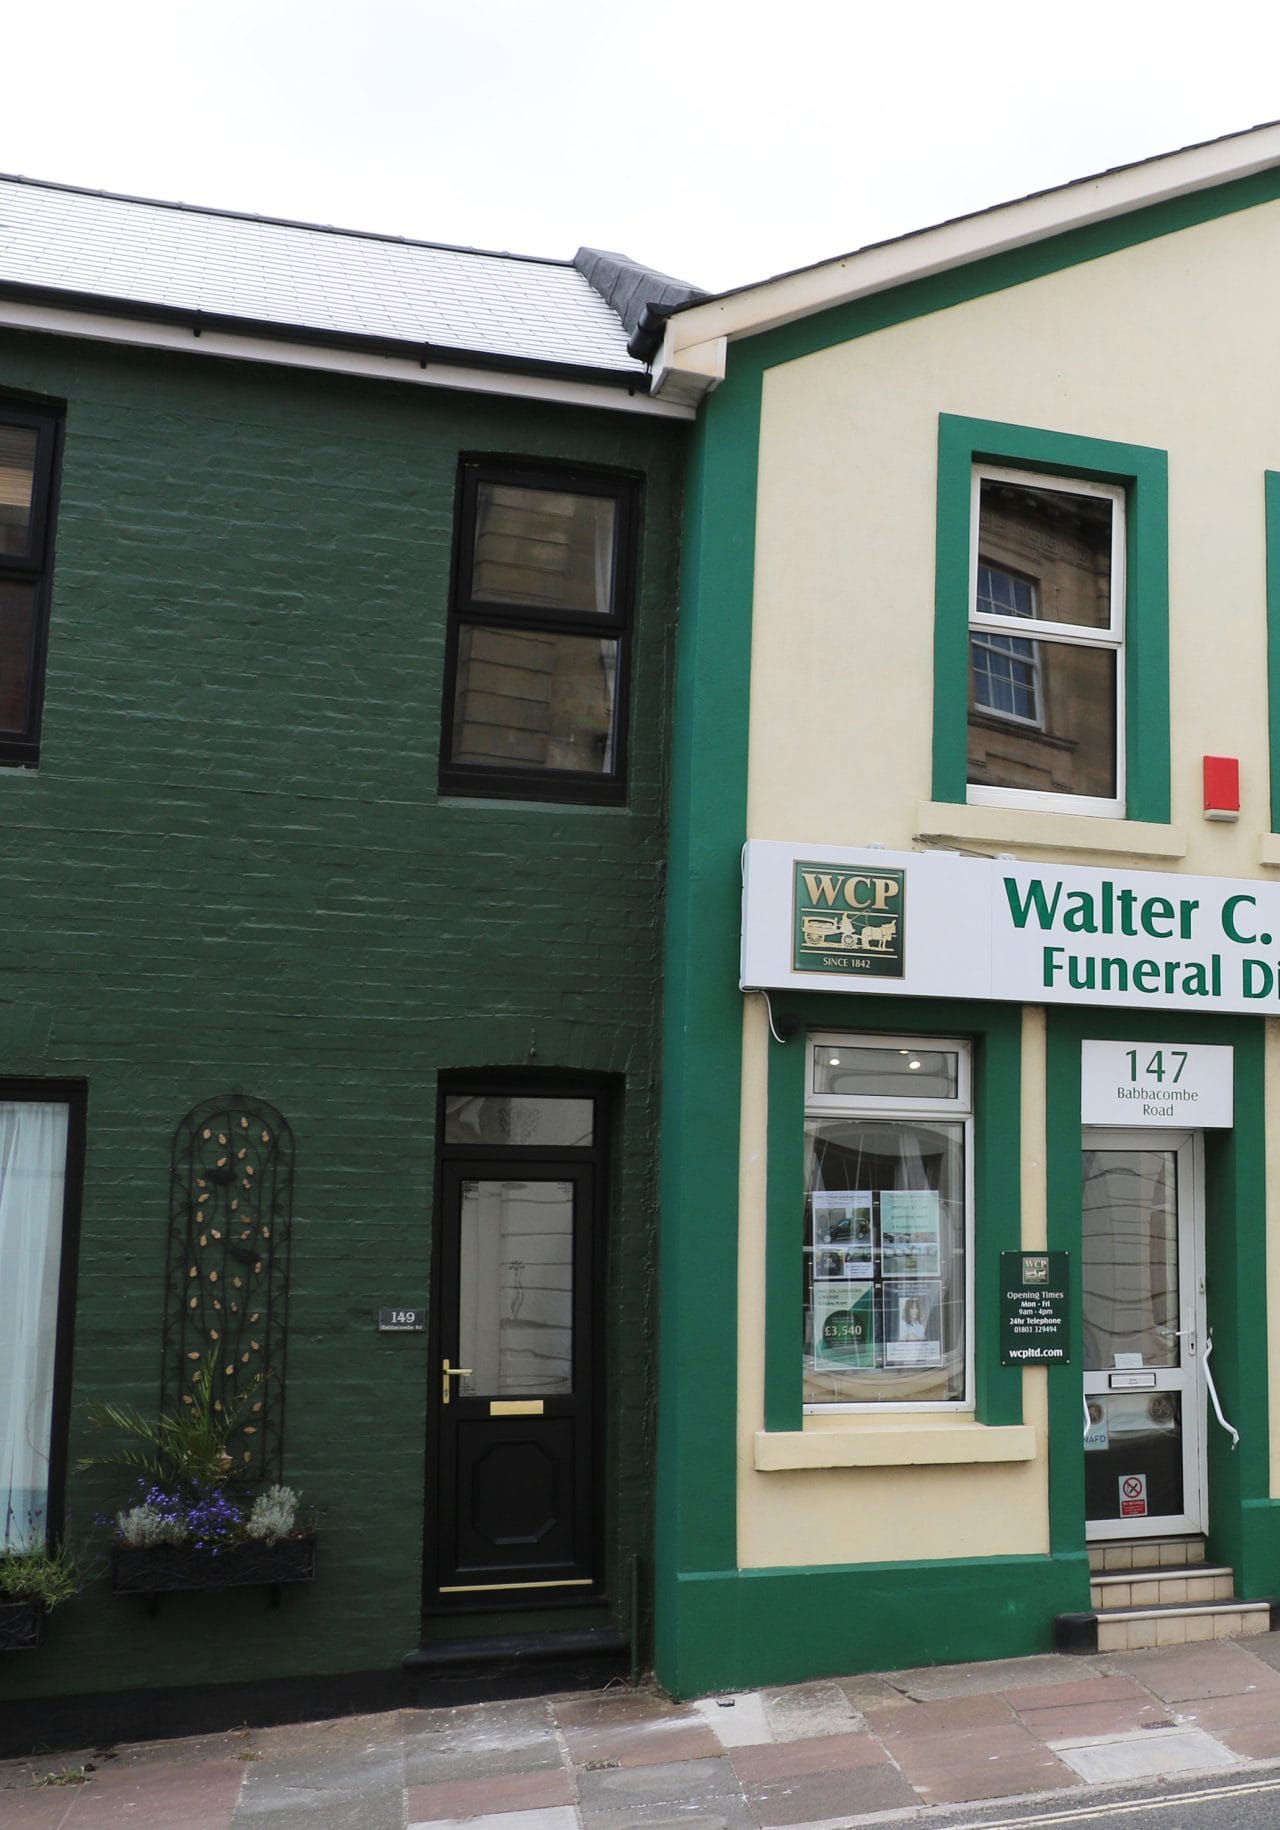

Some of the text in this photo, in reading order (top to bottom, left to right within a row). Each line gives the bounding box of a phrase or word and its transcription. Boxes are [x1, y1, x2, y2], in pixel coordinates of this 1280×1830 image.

[801, 873, 899, 909] WCP
[1003, 877, 1200, 940] Walter
[1221, 894, 1273, 945] C.
[823, 957, 871, 968] SINCE 1842
[1043, 946, 1222, 997] Funeral
[1125, 1049, 1188, 1083] 147
[1117, 1087, 1199, 1101] Babbacombe
[1143, 1104, 1174, 1117] Road
[1025, 1260, 1047, 1269] WCP
[1007, 1291, 1064, 1300] Opening Times
[391, 1311, 415, 1323] 149
[1038, 1308, 1053, 1316] 4pm
[1026, 1318, 1061, 1326] Telephone
[824, 1324, 863, 1337] £3,540
[1034, 1325, 1057, 1333] 329494
[1009, 1347, 1063, 1359] wcpltd.com
